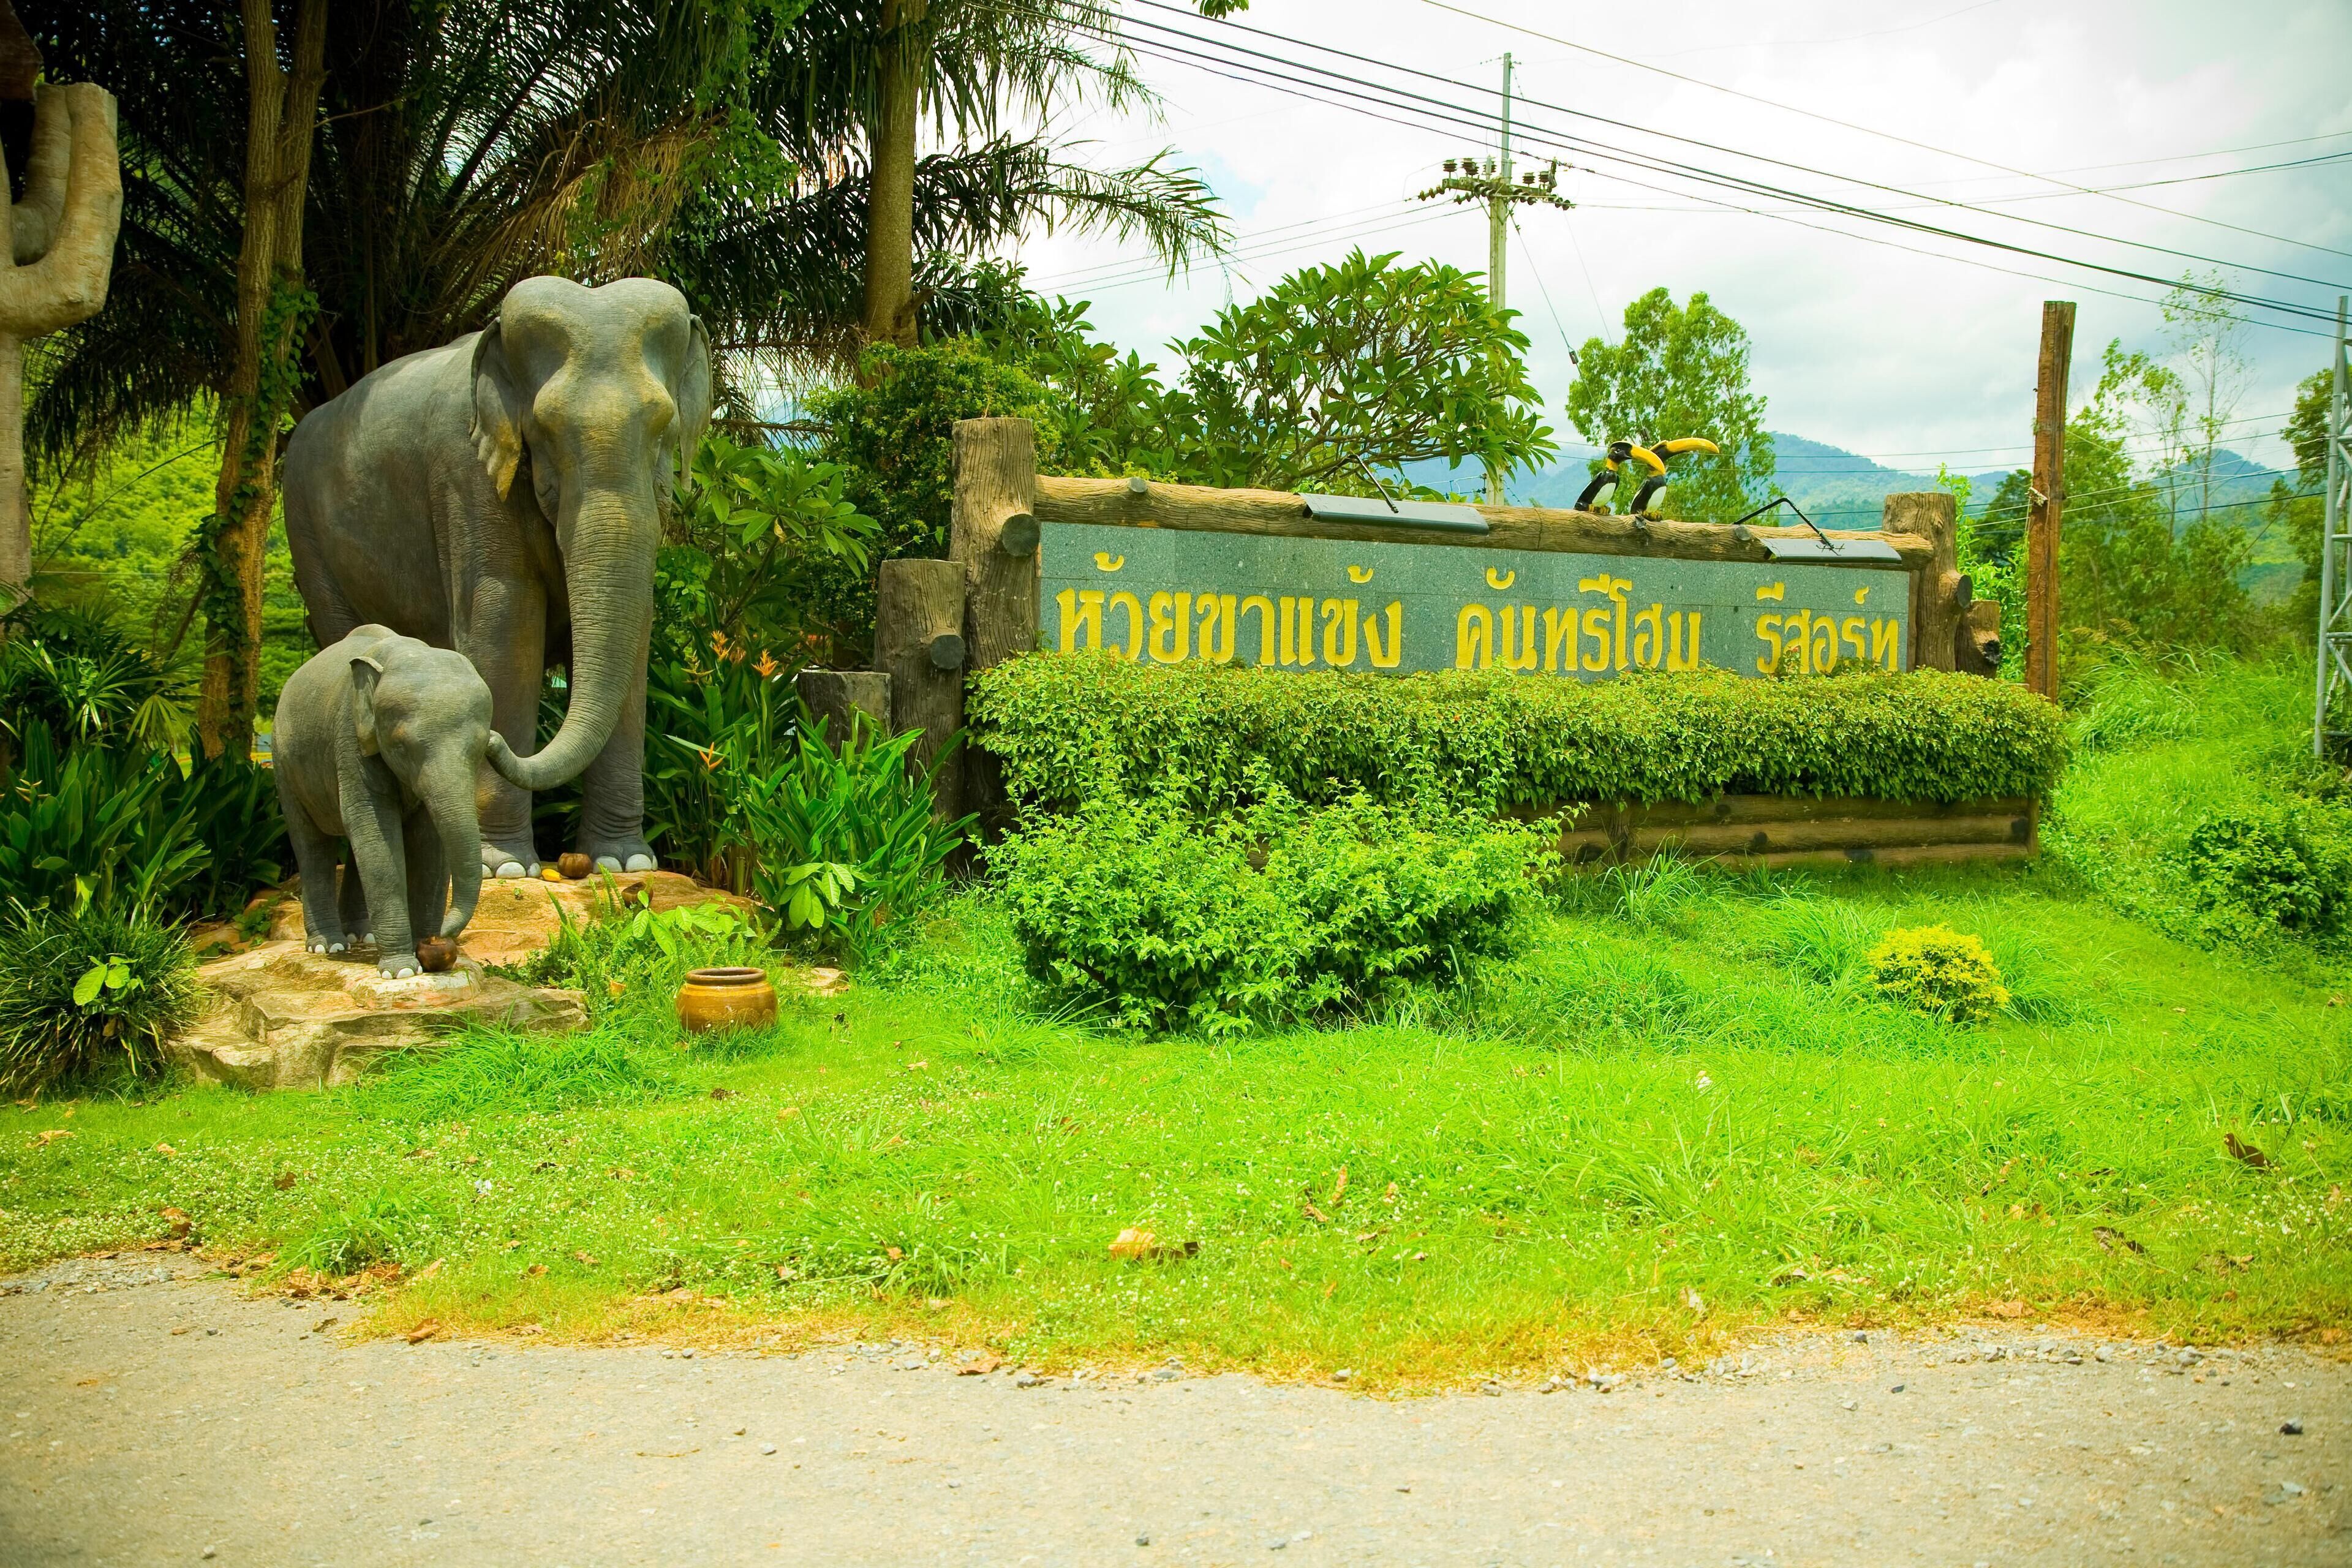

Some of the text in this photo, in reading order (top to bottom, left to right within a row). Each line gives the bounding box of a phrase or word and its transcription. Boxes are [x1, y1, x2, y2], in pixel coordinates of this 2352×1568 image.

[1055, 552, 1899, 674] ห้วยขาแข้ง คันทรีโฮม รีสอร์ท
